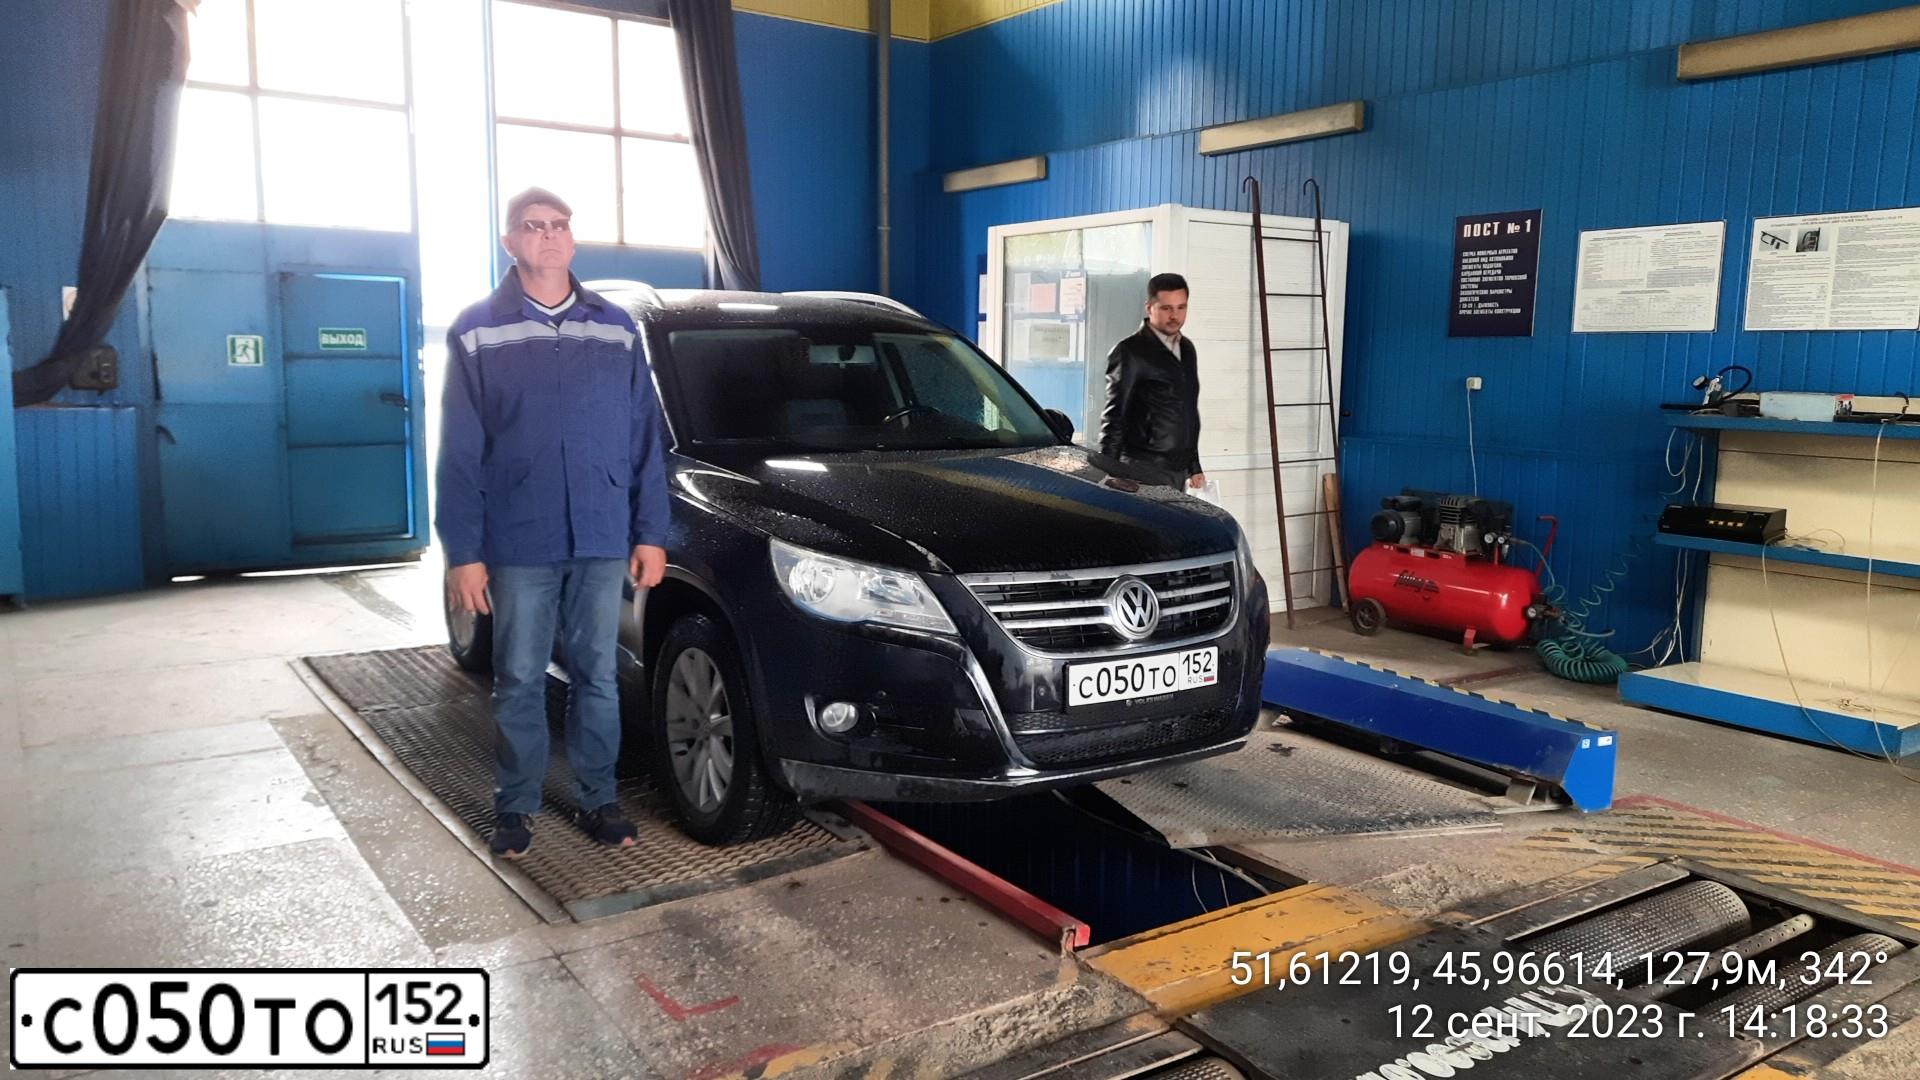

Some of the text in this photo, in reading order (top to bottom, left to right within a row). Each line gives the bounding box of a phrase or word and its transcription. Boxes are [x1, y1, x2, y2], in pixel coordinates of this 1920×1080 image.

[1463, 218, 1532, 238] ПОСТ № 1
[320, 333, 365, 347] ВЫХОД
[1182, 651, 1213, 676] 152
[1188, 675, 1204, 685] RUS
